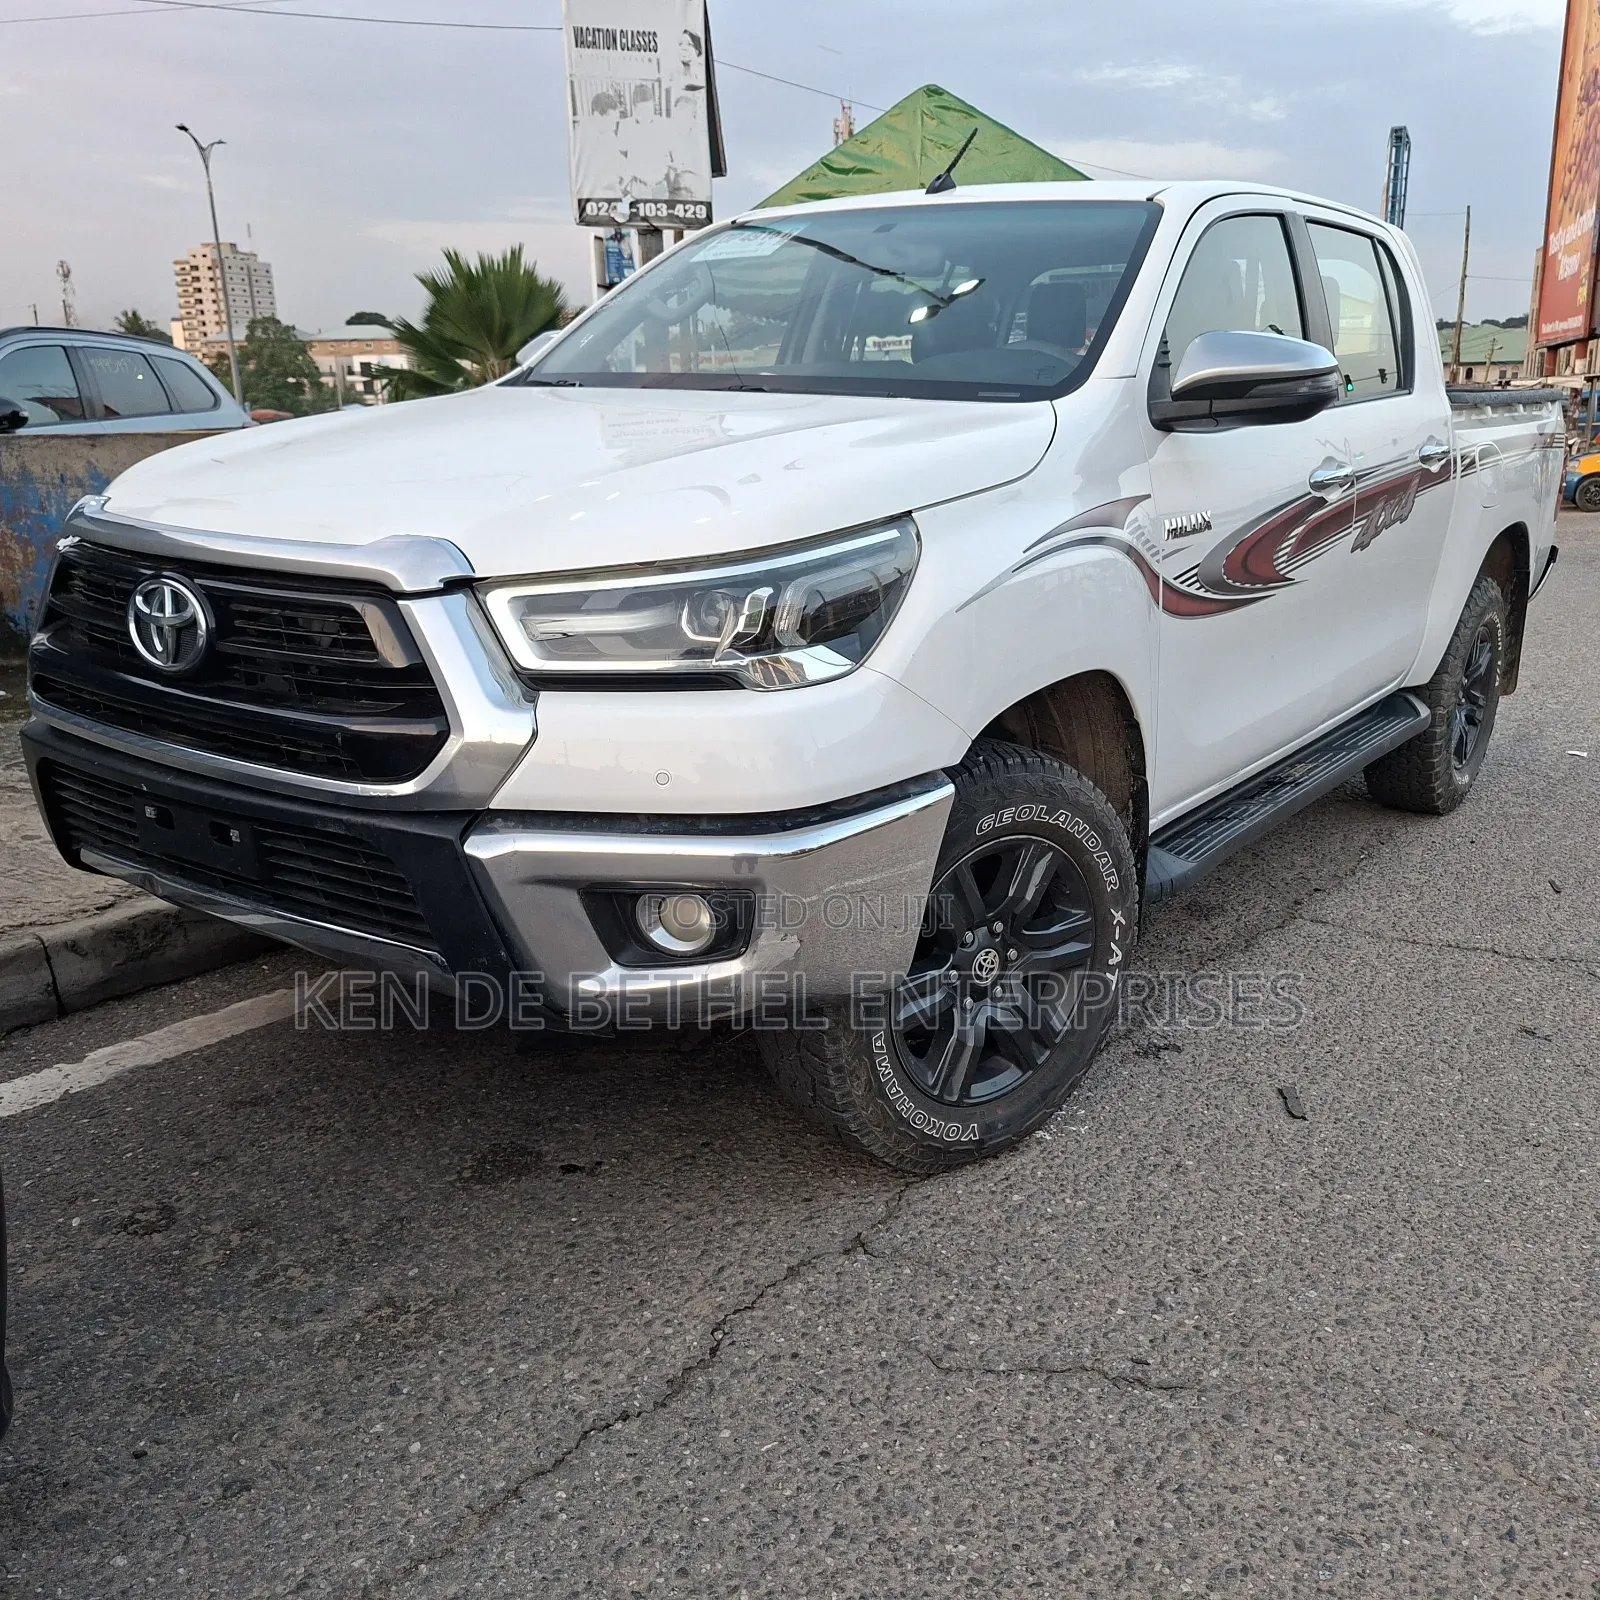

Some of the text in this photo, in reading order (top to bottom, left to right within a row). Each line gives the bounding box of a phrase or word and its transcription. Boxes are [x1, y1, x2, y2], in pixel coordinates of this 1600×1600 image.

[573, 26, 658, 53] VACATION CLASSES
[1163, 509, 1213, 541] HILUX
[975, 804, 1120, 892] GEOLANDAR
[872, 1031, 980, 1141] YOKOHAMA
